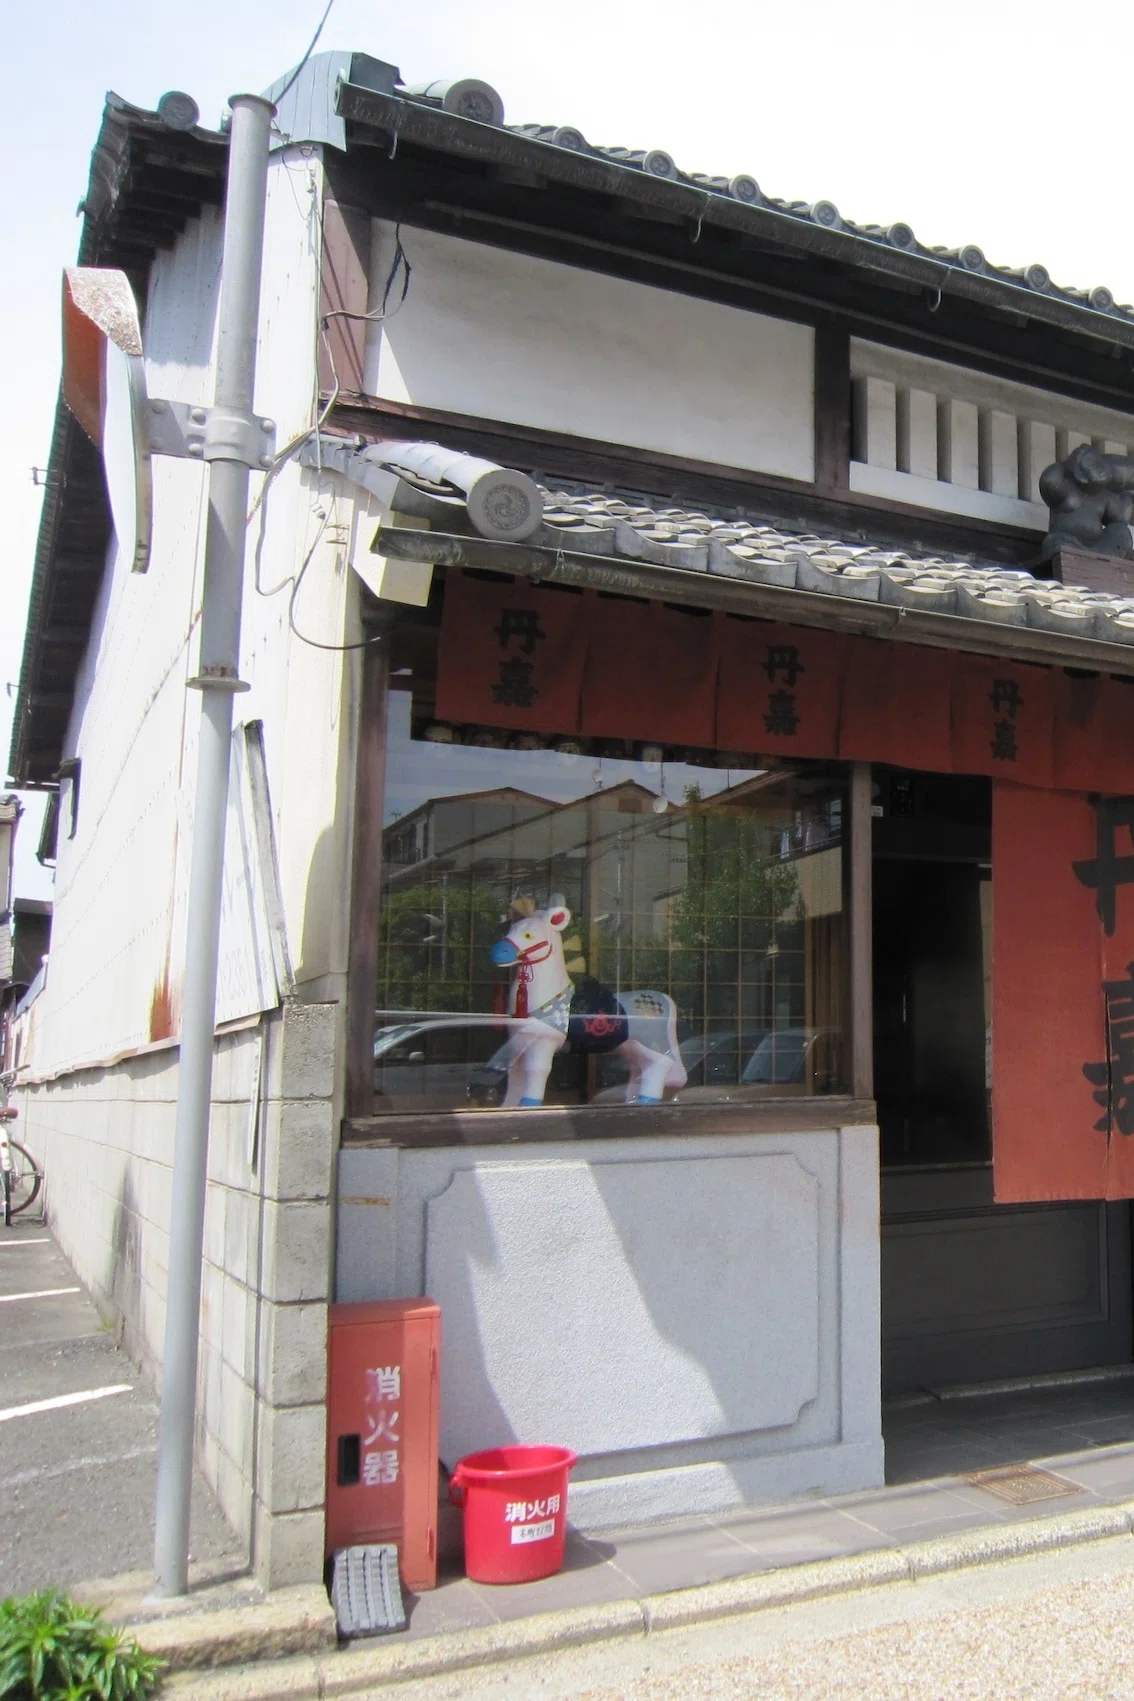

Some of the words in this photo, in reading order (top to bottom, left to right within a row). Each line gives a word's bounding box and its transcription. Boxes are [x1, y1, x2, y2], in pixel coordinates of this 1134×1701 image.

[491, 608, 546, 708] 丹嘉
[763, 644, 805, 736] 丹嘉
[987, 678, 1025, 762] 丹嘉
[363, 1365, 401, 1486] 消火器
[505, 1494, 561, 1523] 消火用
